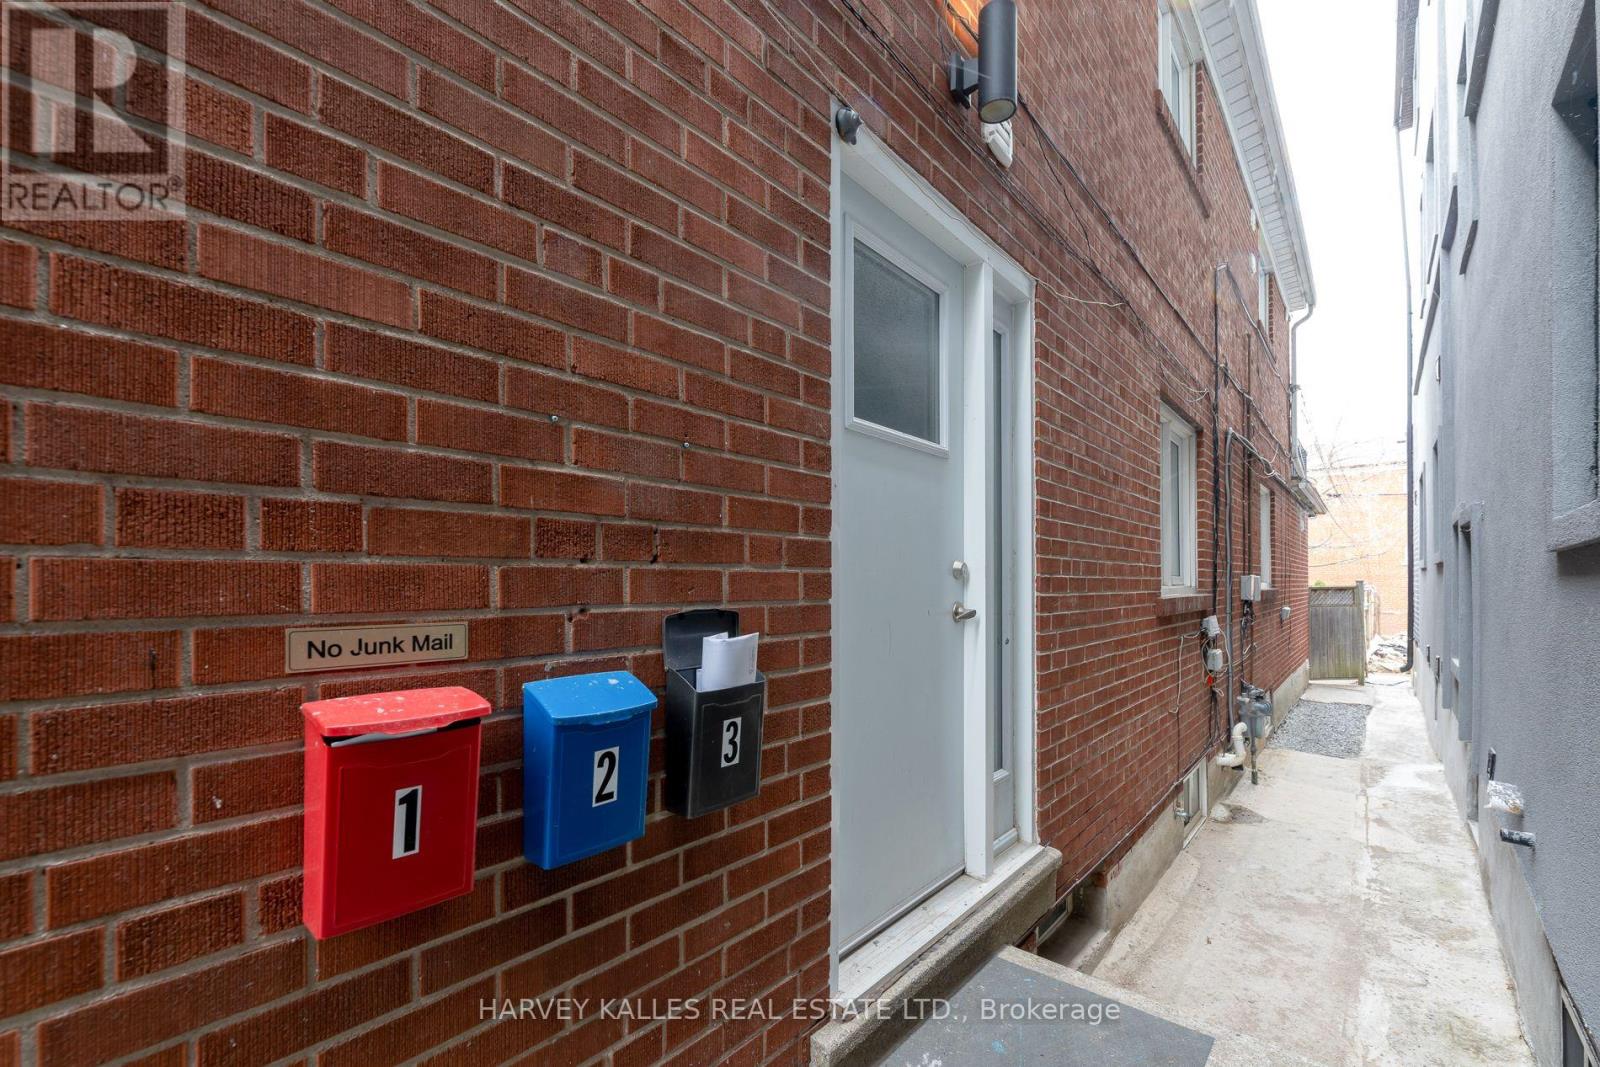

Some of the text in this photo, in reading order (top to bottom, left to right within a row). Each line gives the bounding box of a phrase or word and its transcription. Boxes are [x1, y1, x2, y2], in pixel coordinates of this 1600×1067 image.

[307, 634, 453, 659] No Junk Mail
[723, 720, 739, 764] 3
[594, 750, 616, 804] 2
[398, 787, 420, 854] 1
